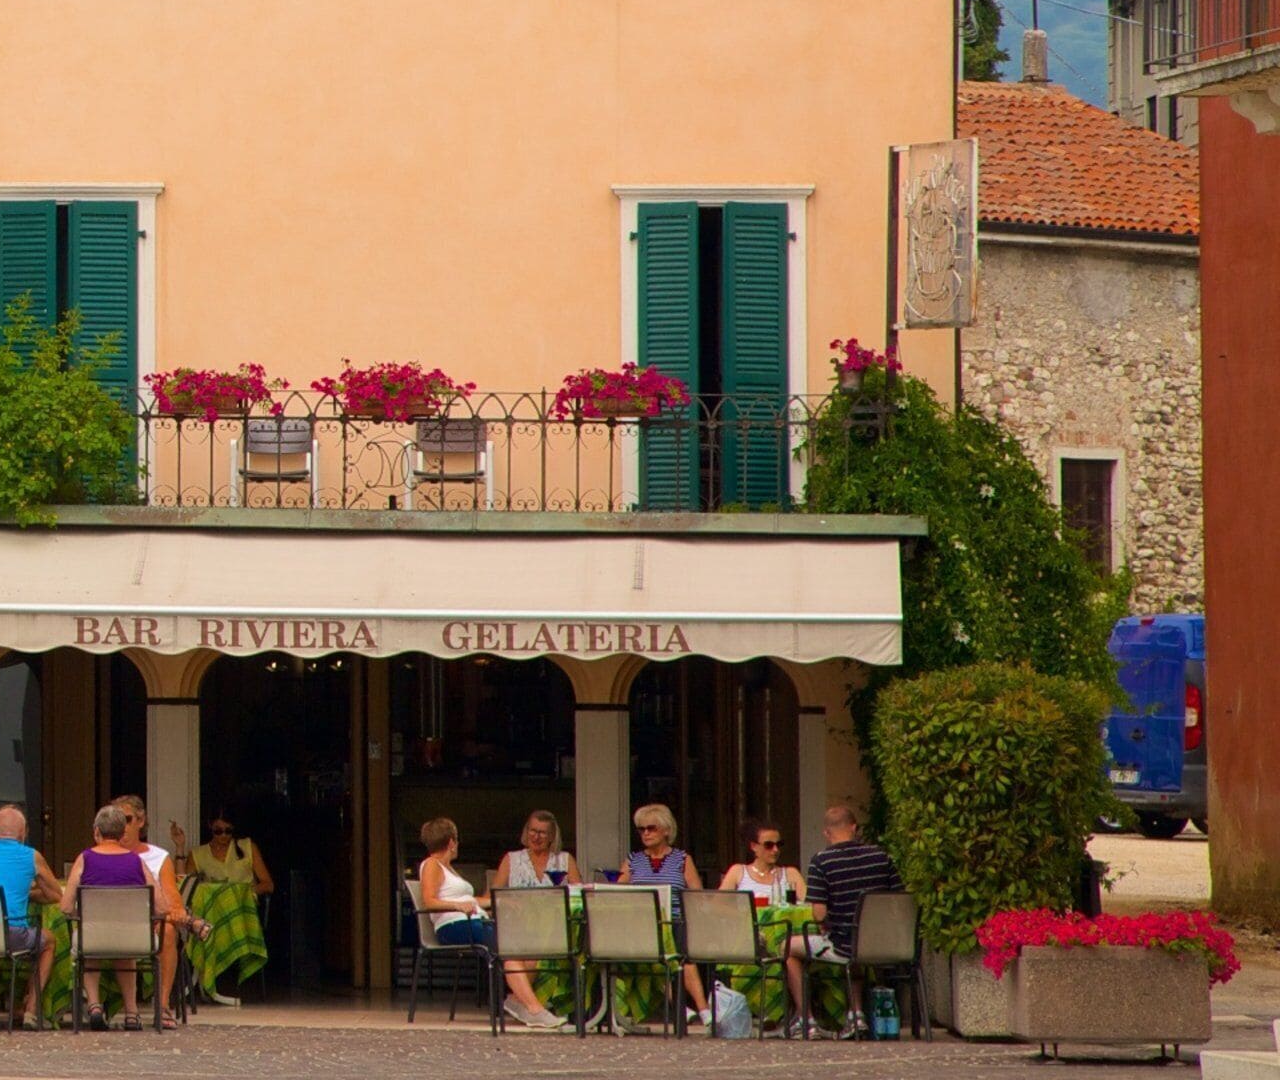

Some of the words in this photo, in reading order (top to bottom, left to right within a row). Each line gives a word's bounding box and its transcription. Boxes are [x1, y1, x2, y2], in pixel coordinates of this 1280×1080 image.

[72, 616, 162, 646] BAR
[196, 618, 379, 649] RIVIERA
[440, 621, 693, 653] GELATERIA
